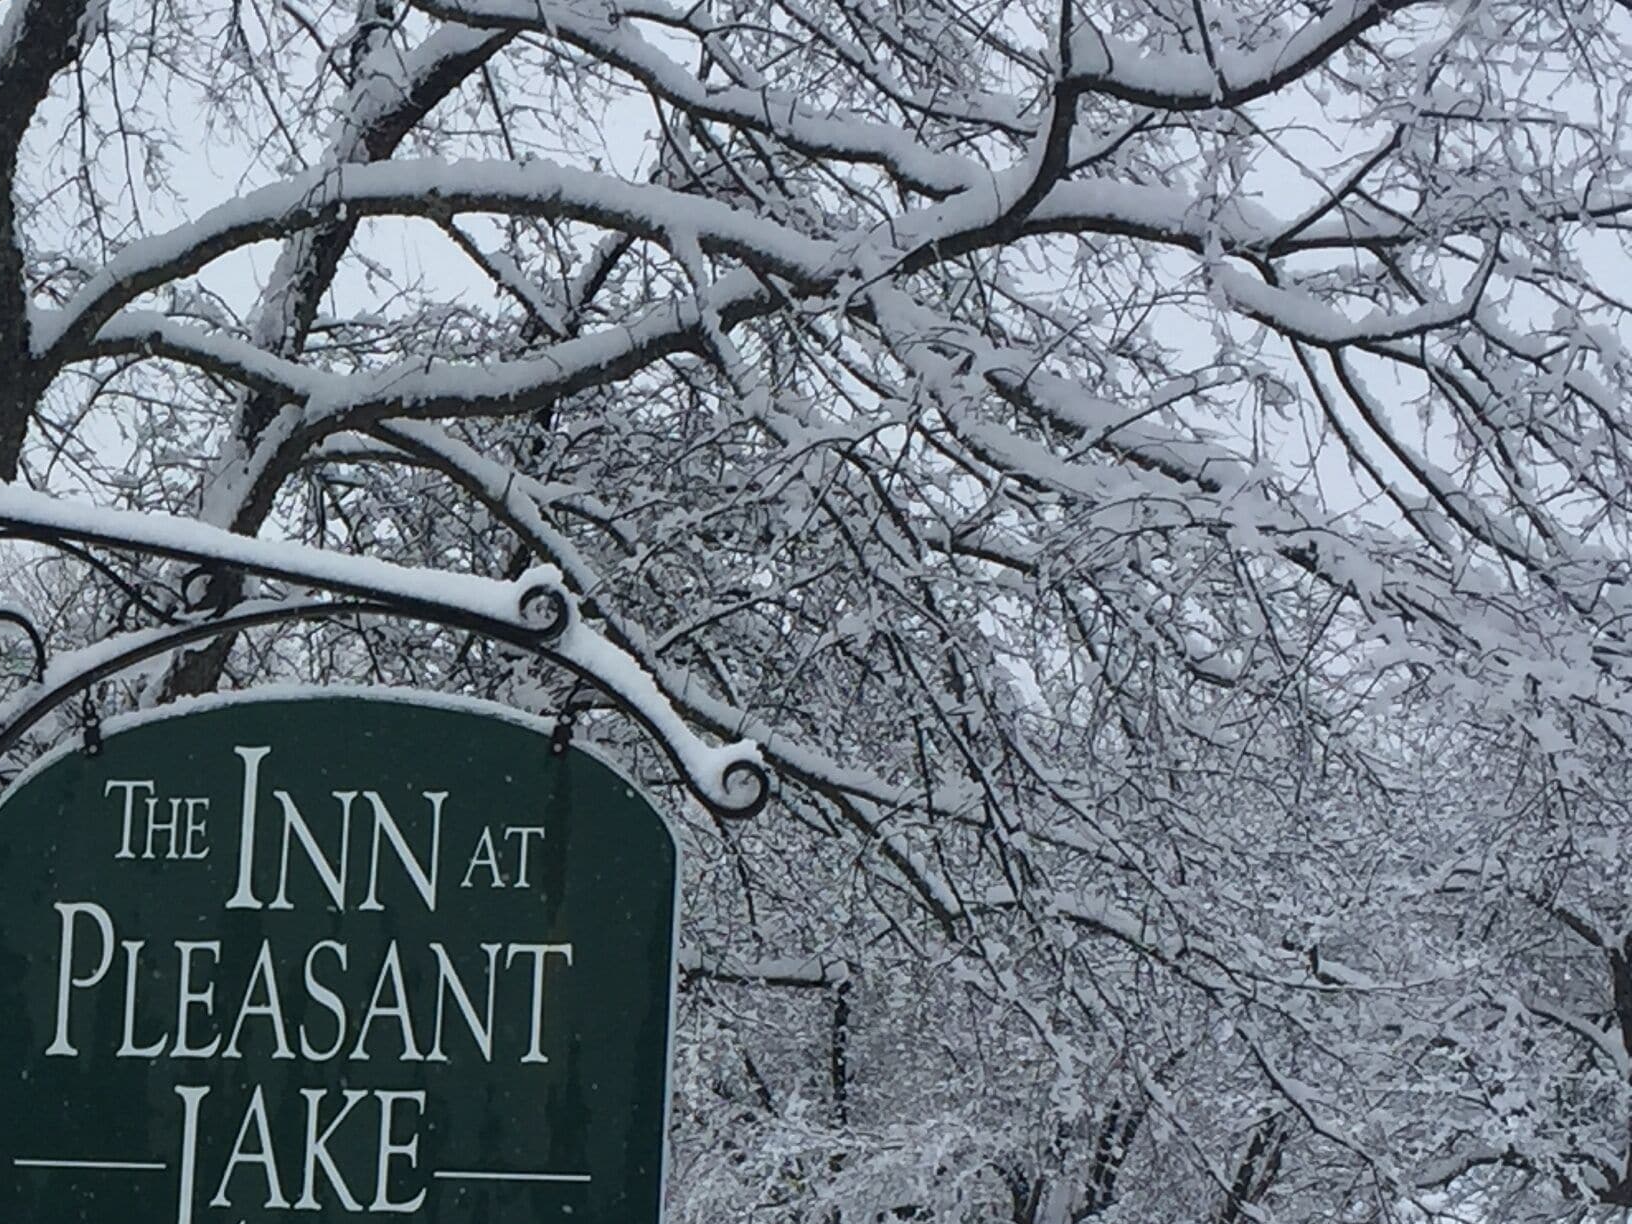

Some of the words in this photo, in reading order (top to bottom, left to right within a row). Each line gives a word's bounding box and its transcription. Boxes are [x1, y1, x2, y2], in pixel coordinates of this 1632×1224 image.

[105, 780, 210, 859] THE
[225, 746, 449, 911] INN
[461, 826, 546, 888] AT
[45, 902, 573, 1063] PLEASANT
